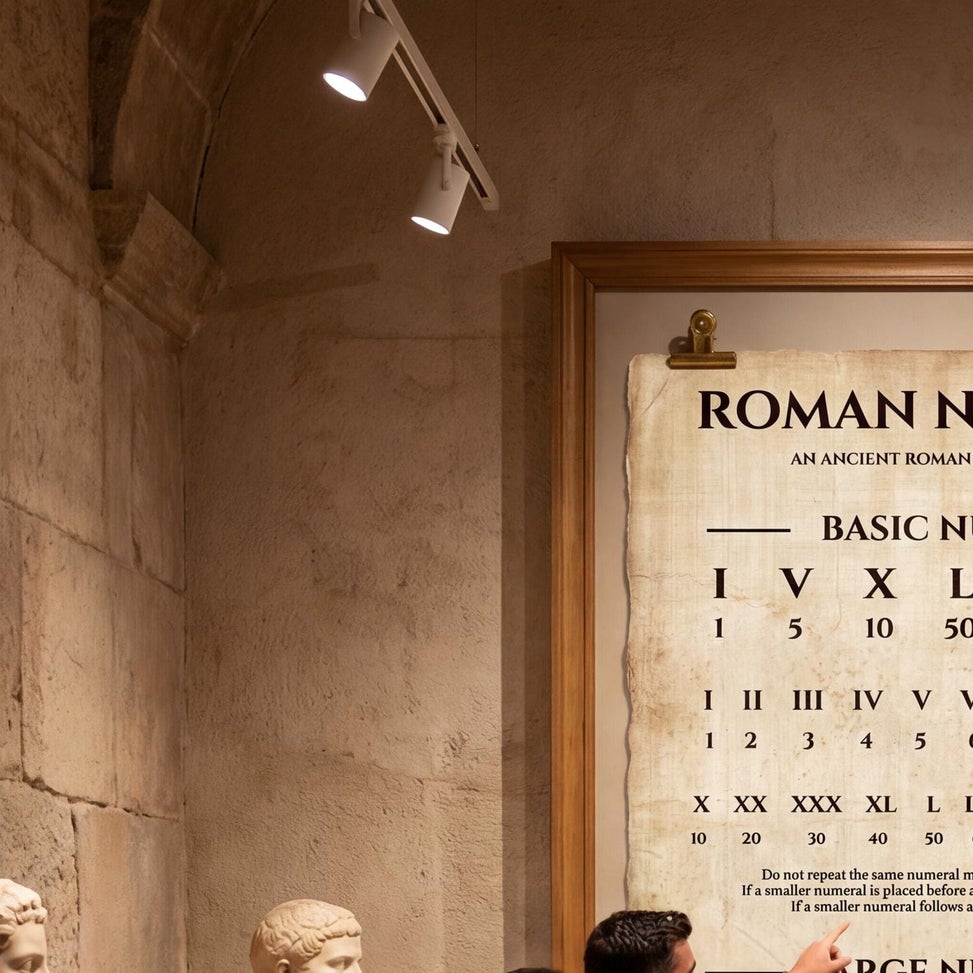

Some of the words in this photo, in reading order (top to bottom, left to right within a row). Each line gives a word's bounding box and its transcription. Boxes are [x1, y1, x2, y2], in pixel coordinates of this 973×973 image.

[697, 389, 918, 430] ROMAN
[790, 452, 816, 466] AN
[820, 452, 901, 466] ANCIENT
[905, 452, 971, 466] ROMAN
[822, 514, 929, 542] BASIC
[713, 567, 728, 599] I
[778, 567, 815, 600] V
[862, 567, 898, 599] X
[713, 617, 724, 638] 1
[788, 617, 803, 640] 5
[865, 617, 894, 639] 10
[703, 689, 713, 711] I
[743, 689, 763, 711] II
[792, 689, 823, 711] III
[852, 689, 884, 711] IV
[911, 689, 933, 711] V
[704, 732, 714, 749] 1
[744, 731, 757, 749] 2
[802, 731, 815, 750] 3
[860, 732, 873, 749] 4
[914, 731, 926, 750] 5
[692, 795, 711, 813] X
[733, 795, 768, 813] XX
[790, 795, 843, 813] XXX
[865, 795, 898, 813] XL
[927, 795, 941, 813] L
[691, 831, 707, 845] 10
[741, 831, 762, 845] 20
[807, 832, 826, 846] 30
[867, 832, 888, 845] 40
[924, 831, 944, 846] 50
[761, 868, 781, 881] Do
[783, 869, 805, 881] not
[807, 869, 847, 884] repeat
[849, 867, 869, 881] the
[871, 871, 904, 881] same
[907, 867, 960, 881] numeral
[741, 883, 754, 896] If
[754, 887, 762, 896] a
[764, 883, 812, 897] smaller
[814, 883, 867, 897] numeral
[869, 884, 880, 896] is
[882, 883, 924, 900] placed
[926, 883, 967, 897] before
[790, 899, 804, 913] If
[803, 903, 811, 913] a
[814, 899, 861, 913] smaller
[863, 899, 917, 913] numeral
[919, 899, 964, 913] follows
[966, 903, 973, 913] a
